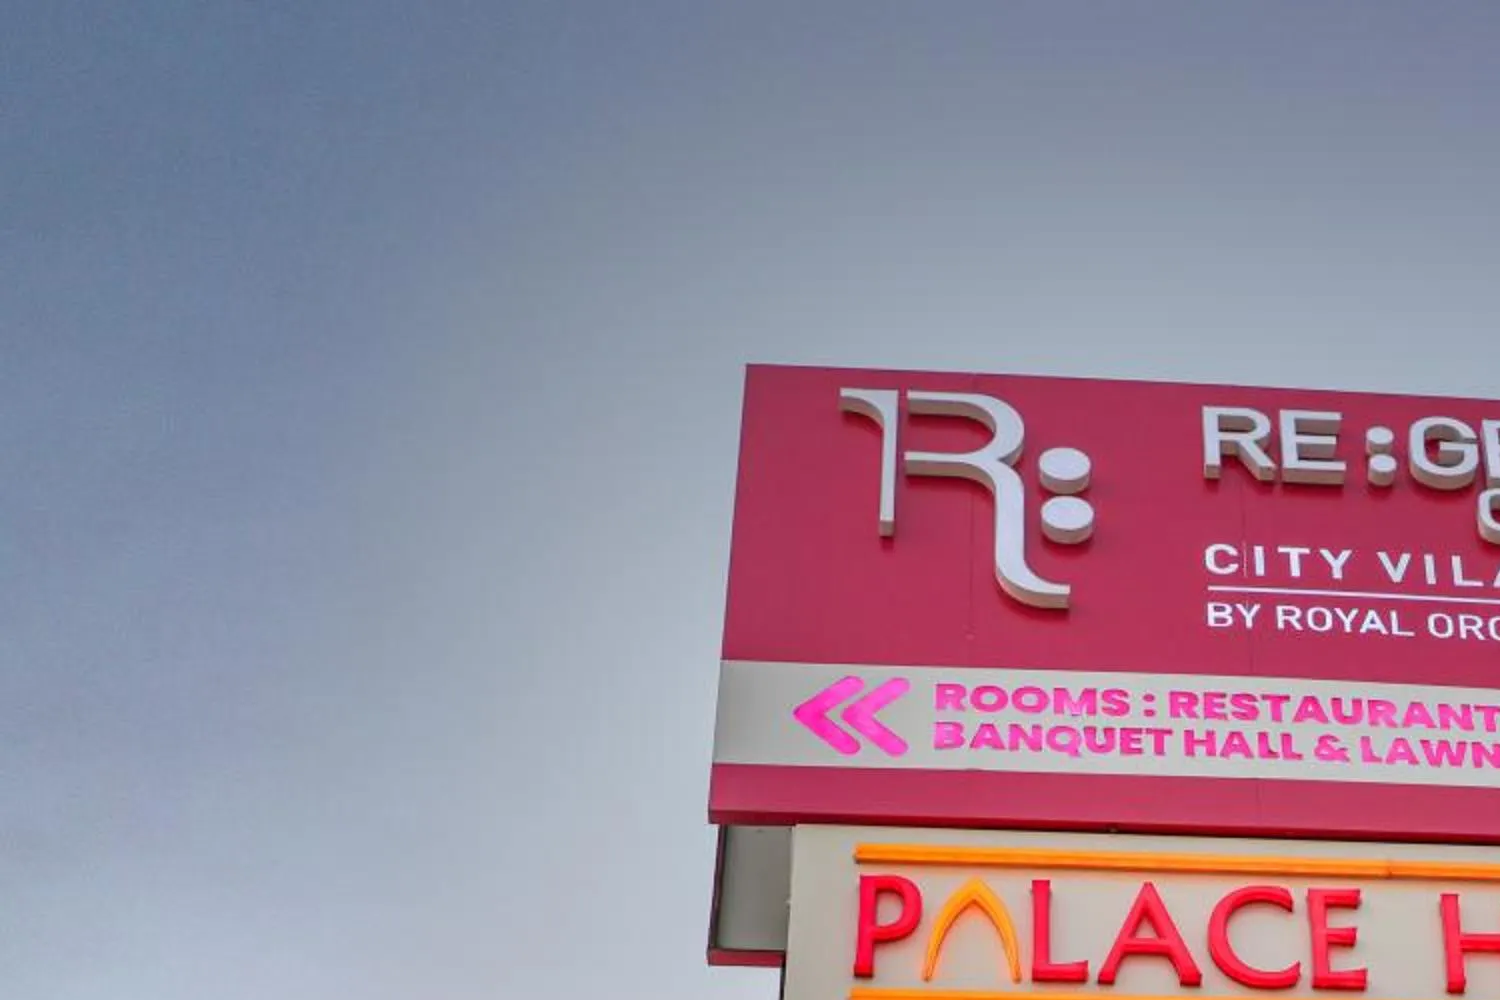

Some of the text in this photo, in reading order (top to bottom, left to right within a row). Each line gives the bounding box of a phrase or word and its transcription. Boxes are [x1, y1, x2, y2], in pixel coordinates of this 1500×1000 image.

[1204, 543, 1352, 579] CITY
[1207, 603, 1260, 628] BY
[1277, 605, 1415, 637] ROYAL
[933, 683, 1131, 717] ROOMS
[932, 721, 1173, 758] BANQUET
[1183, 728, 1303, 762] HALL
[1314, 734, 1350, 764] &
[853, 874, 1368, 990] PALACE
